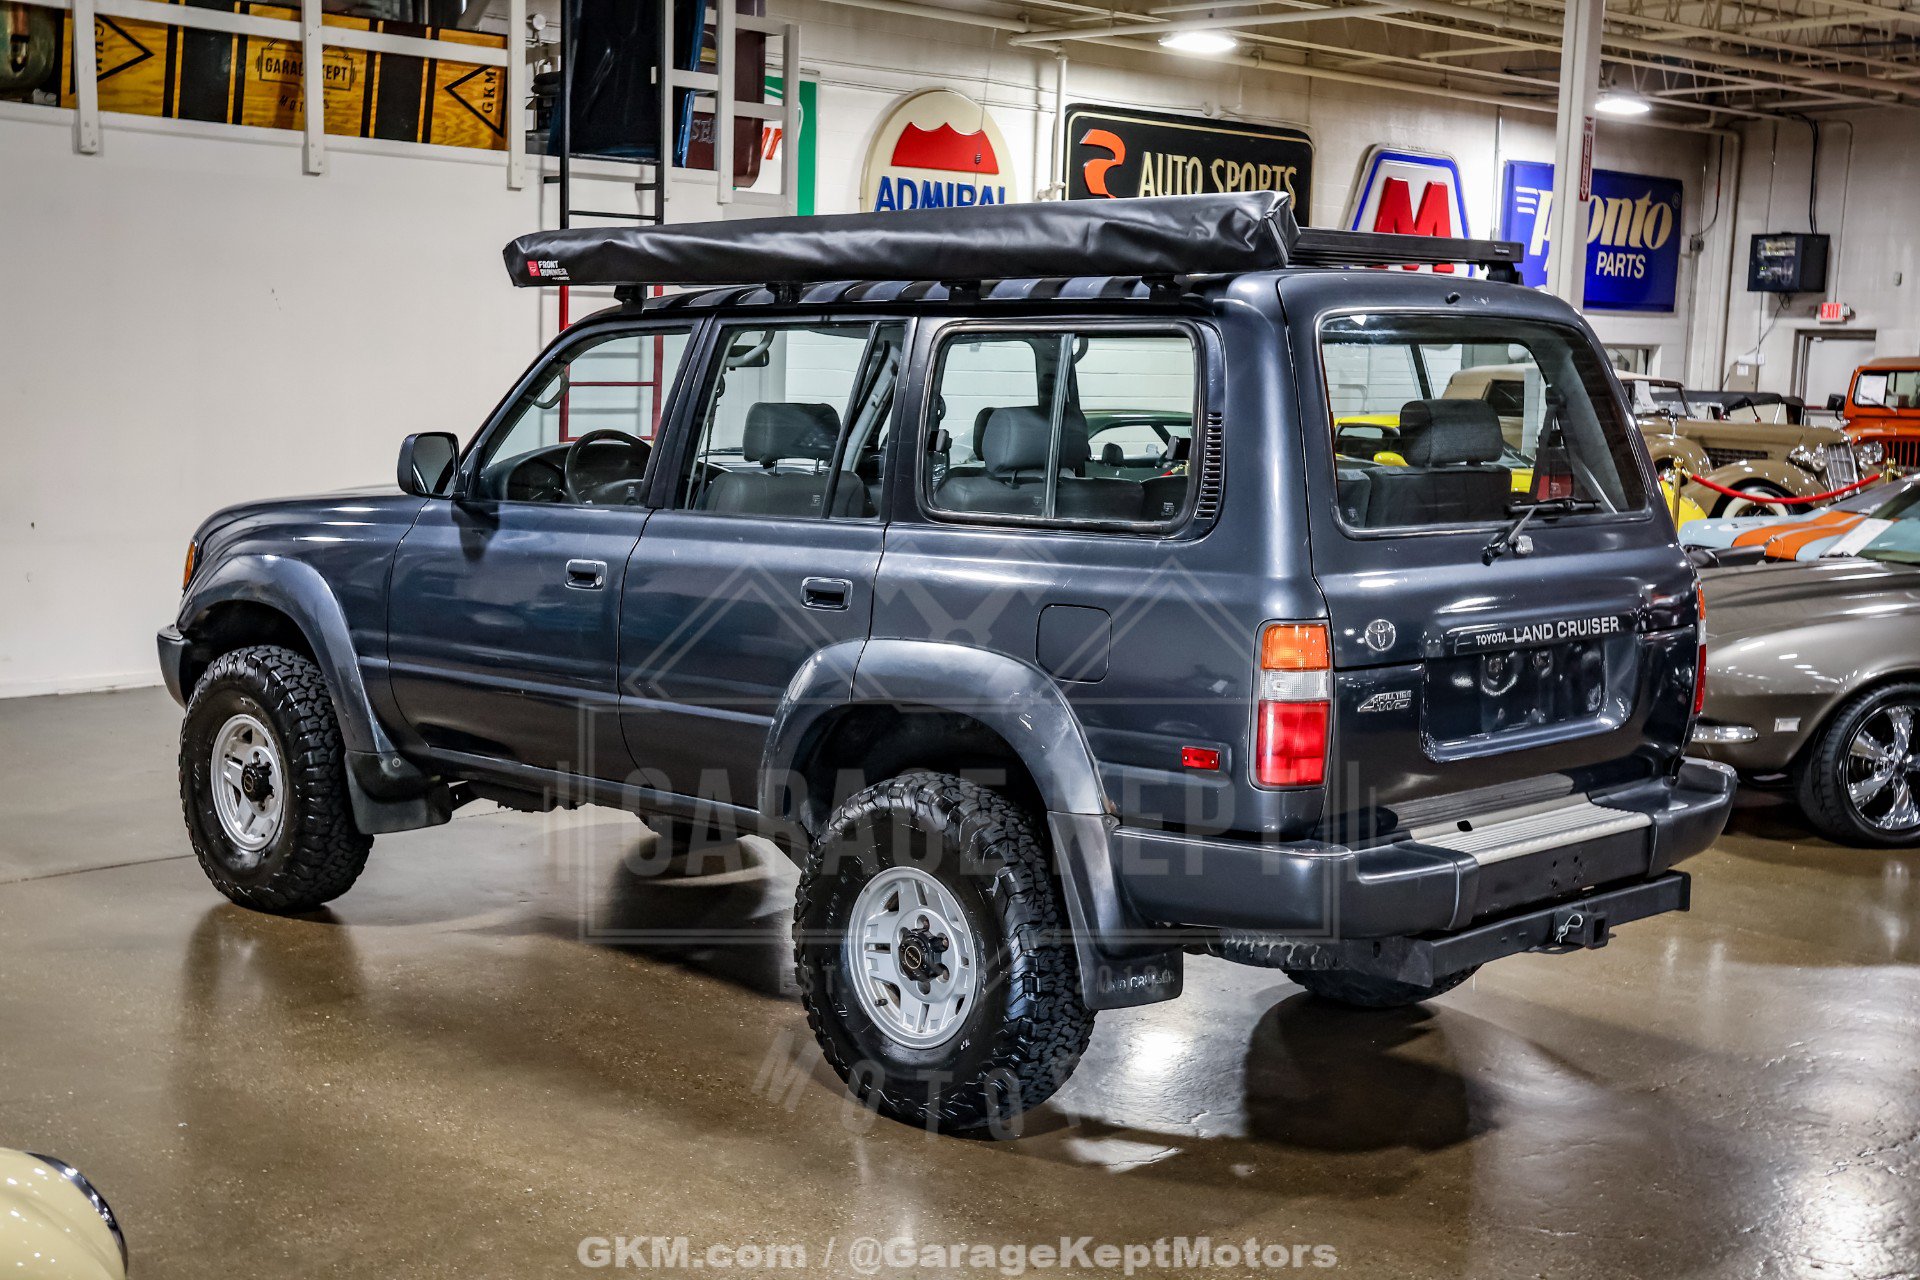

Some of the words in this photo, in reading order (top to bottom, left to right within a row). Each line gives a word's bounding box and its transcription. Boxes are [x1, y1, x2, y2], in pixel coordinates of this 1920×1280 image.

[482, 71, 497, 114] GKM
[1137, 151, 1204, 198] AUTO
[1595, 251, 1646, 279] PARTS
[1820, 302, 1842, 319] EXIT
[1475, 631, 1508, 646] TOYOTA
[1513, 622, 1554, 644] LAND
[1556, 615, 1620, 638] CRUISER
